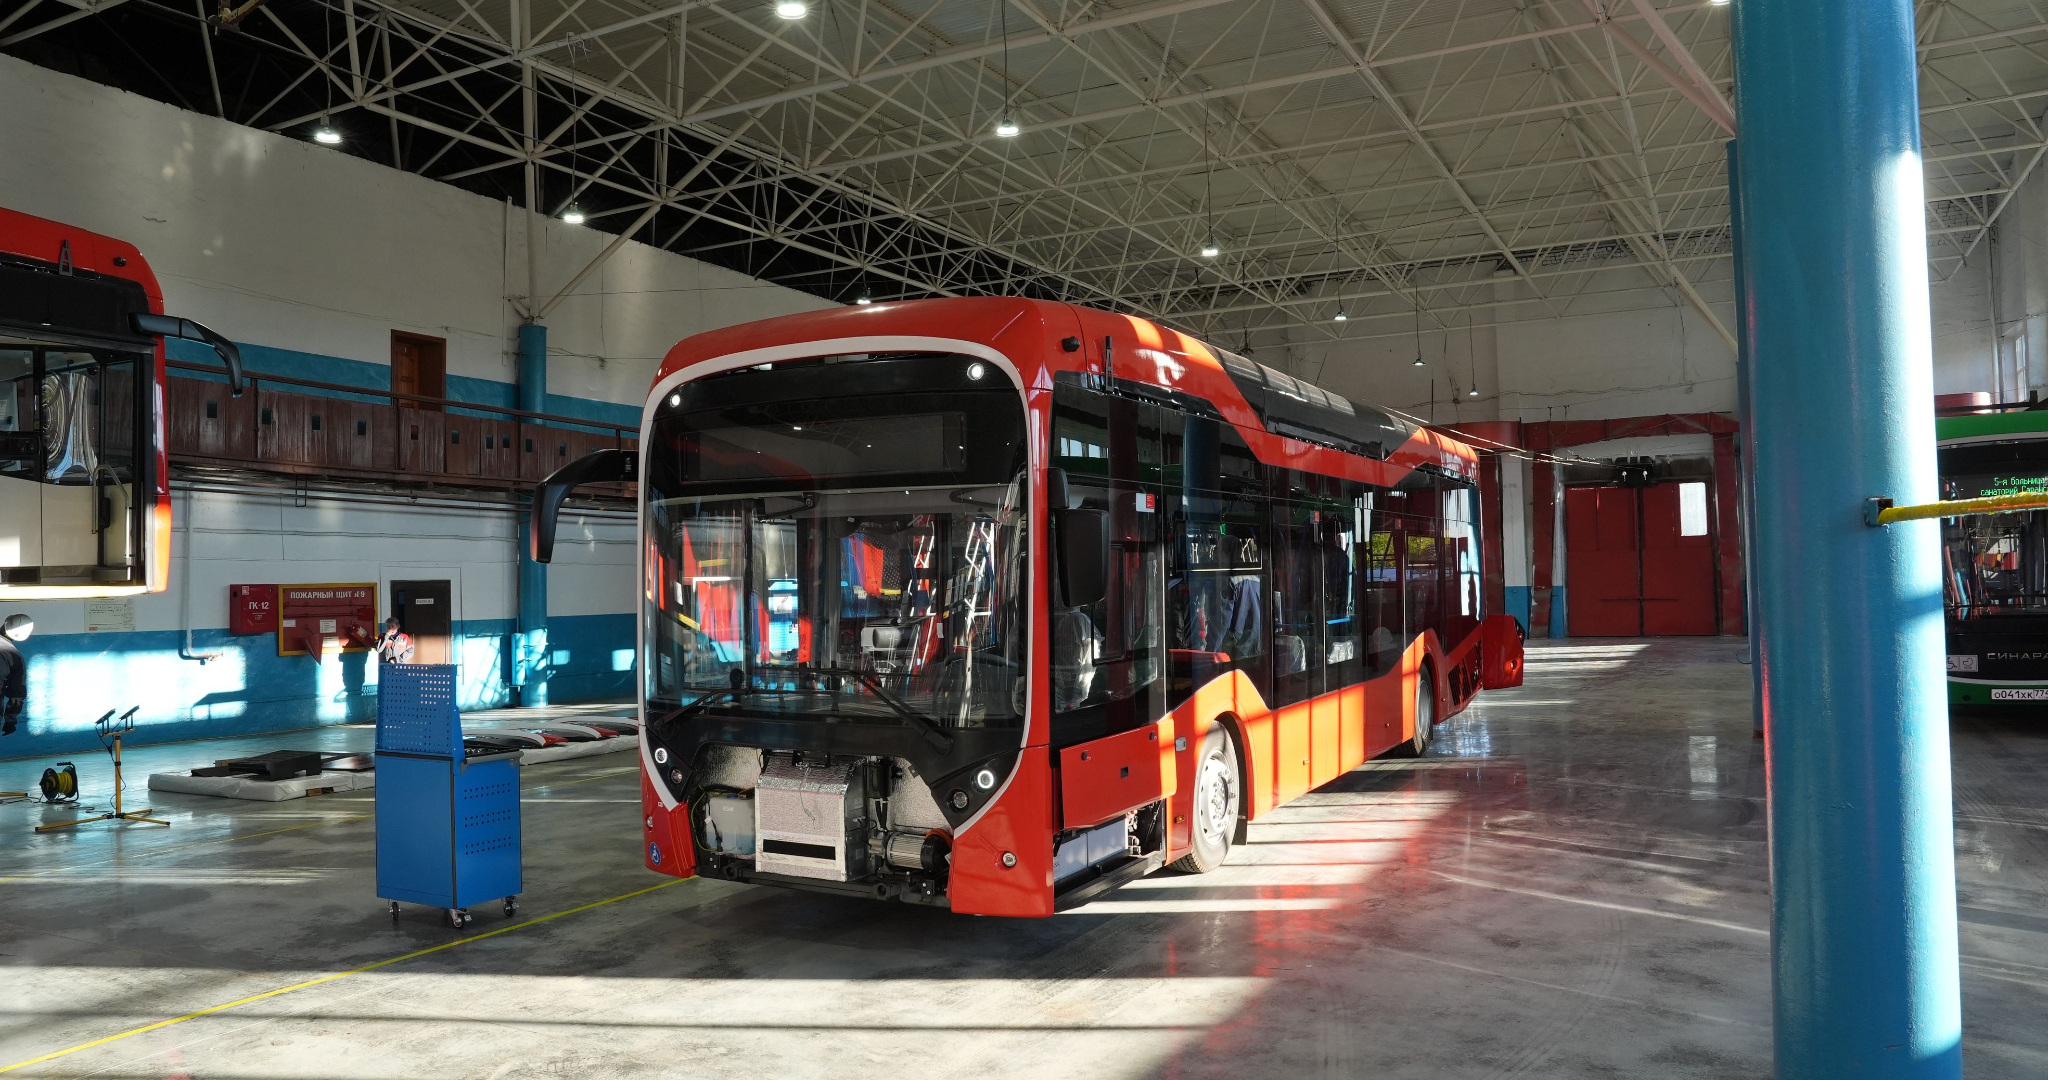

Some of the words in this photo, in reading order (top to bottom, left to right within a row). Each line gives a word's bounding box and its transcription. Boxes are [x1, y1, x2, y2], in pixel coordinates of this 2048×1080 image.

[1994, 477, 2008, 486] 5-я
[1981, 486, 2018, 496] санаторий
[290, 591, 334, 599] ПОЖАРНЫЙ
